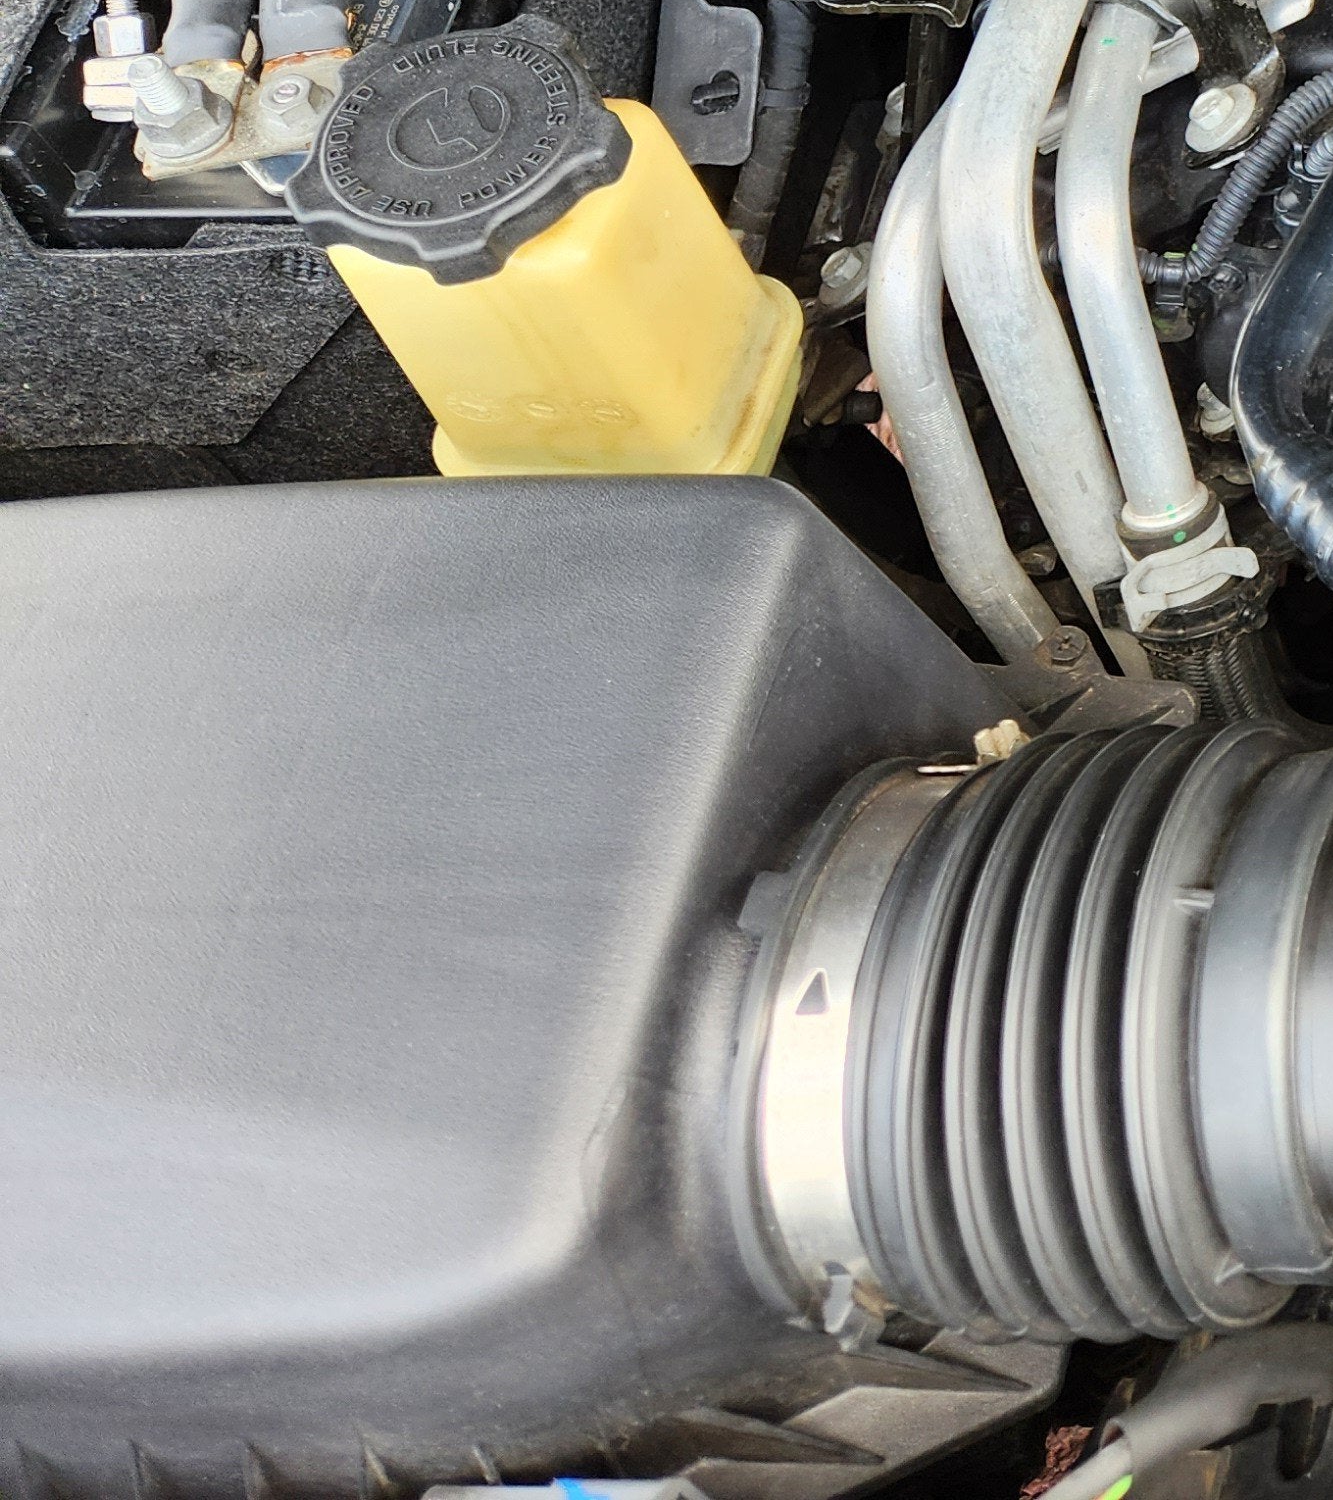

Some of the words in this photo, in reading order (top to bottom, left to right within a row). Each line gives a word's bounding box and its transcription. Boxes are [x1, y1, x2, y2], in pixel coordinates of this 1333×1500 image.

[392, 37, 478, 74] FLUID
[490, 40, 570, 128] STEERING
[328, 84, 376, 201] APPROVED
[457, 135, 559, 209] POWER
[371, 194, 433, 217] USE
